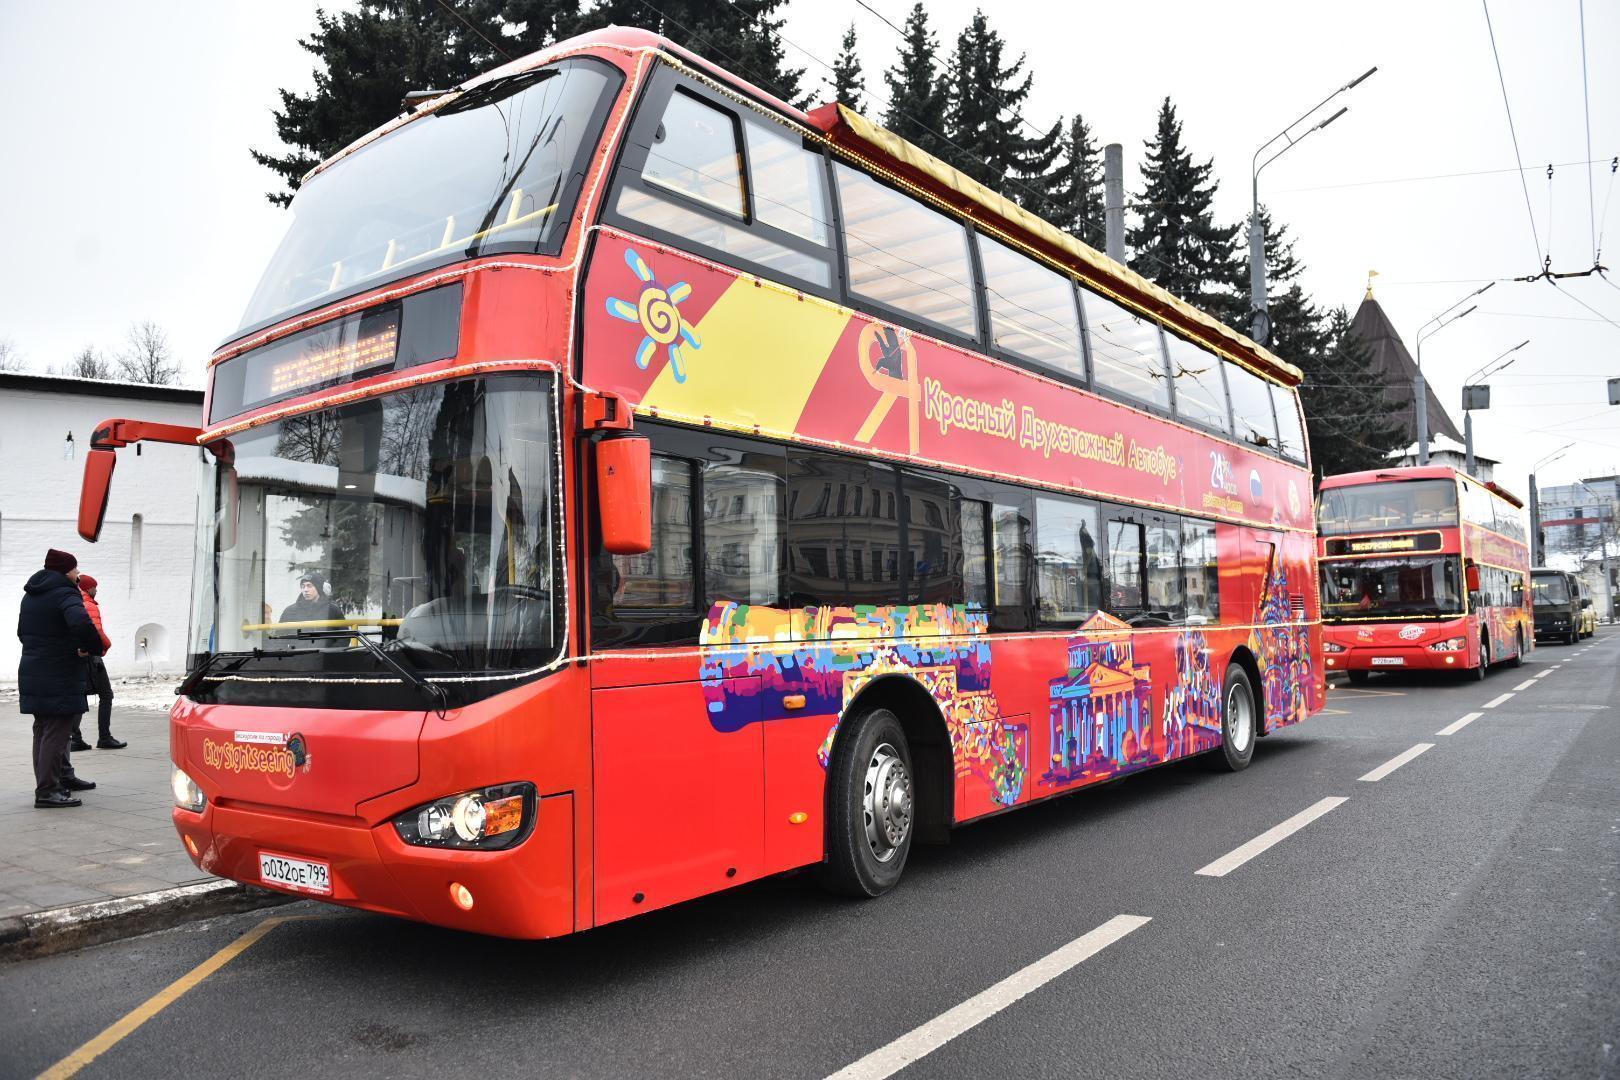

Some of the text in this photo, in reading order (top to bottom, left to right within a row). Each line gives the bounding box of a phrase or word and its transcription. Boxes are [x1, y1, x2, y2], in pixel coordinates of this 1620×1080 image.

[923, 376, 1178, 486] Красный Двухэтажный Автобус
[203, 738, 224, 770] City
[223, 742, 296, 779] Sightseeing
